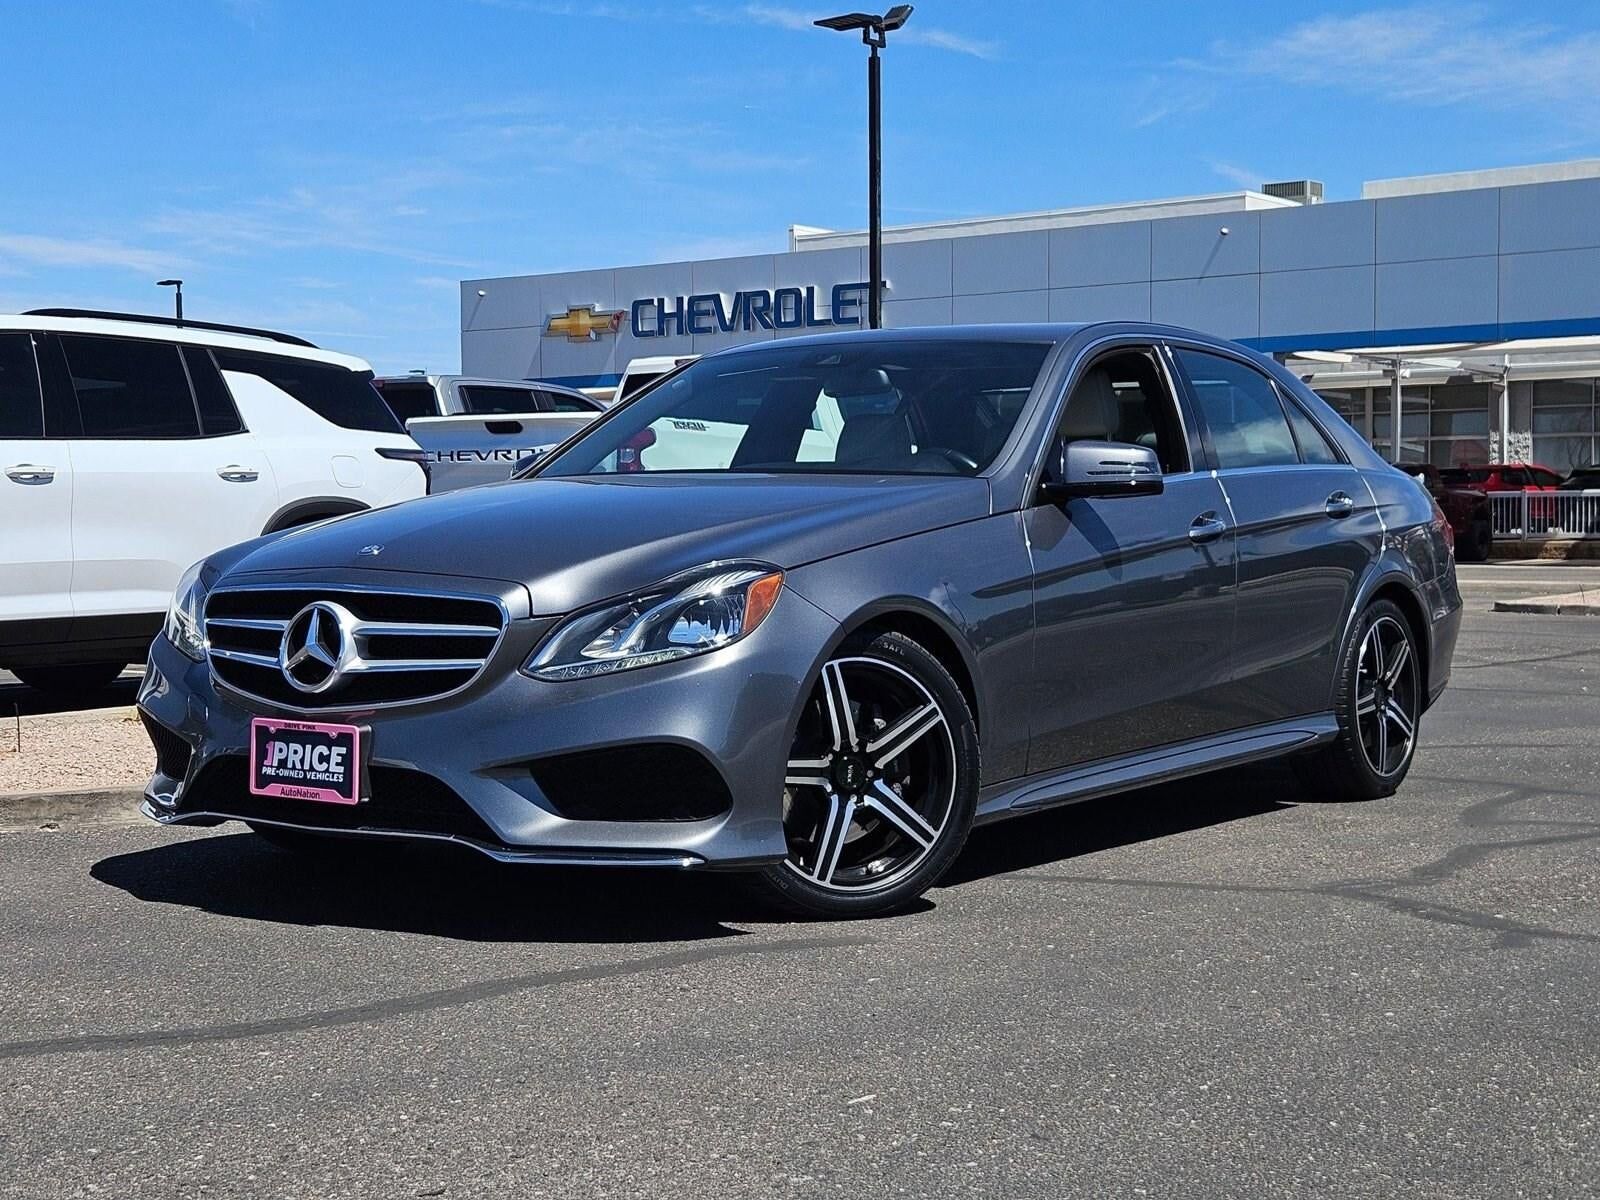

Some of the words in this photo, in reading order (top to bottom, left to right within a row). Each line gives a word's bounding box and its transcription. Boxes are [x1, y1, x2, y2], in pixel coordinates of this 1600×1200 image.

[262, 766, 304, 779] PRE-OWNED
[306, 771, 344, 782] VEHICLES
[280, 787, 320, 799] AutoNation
